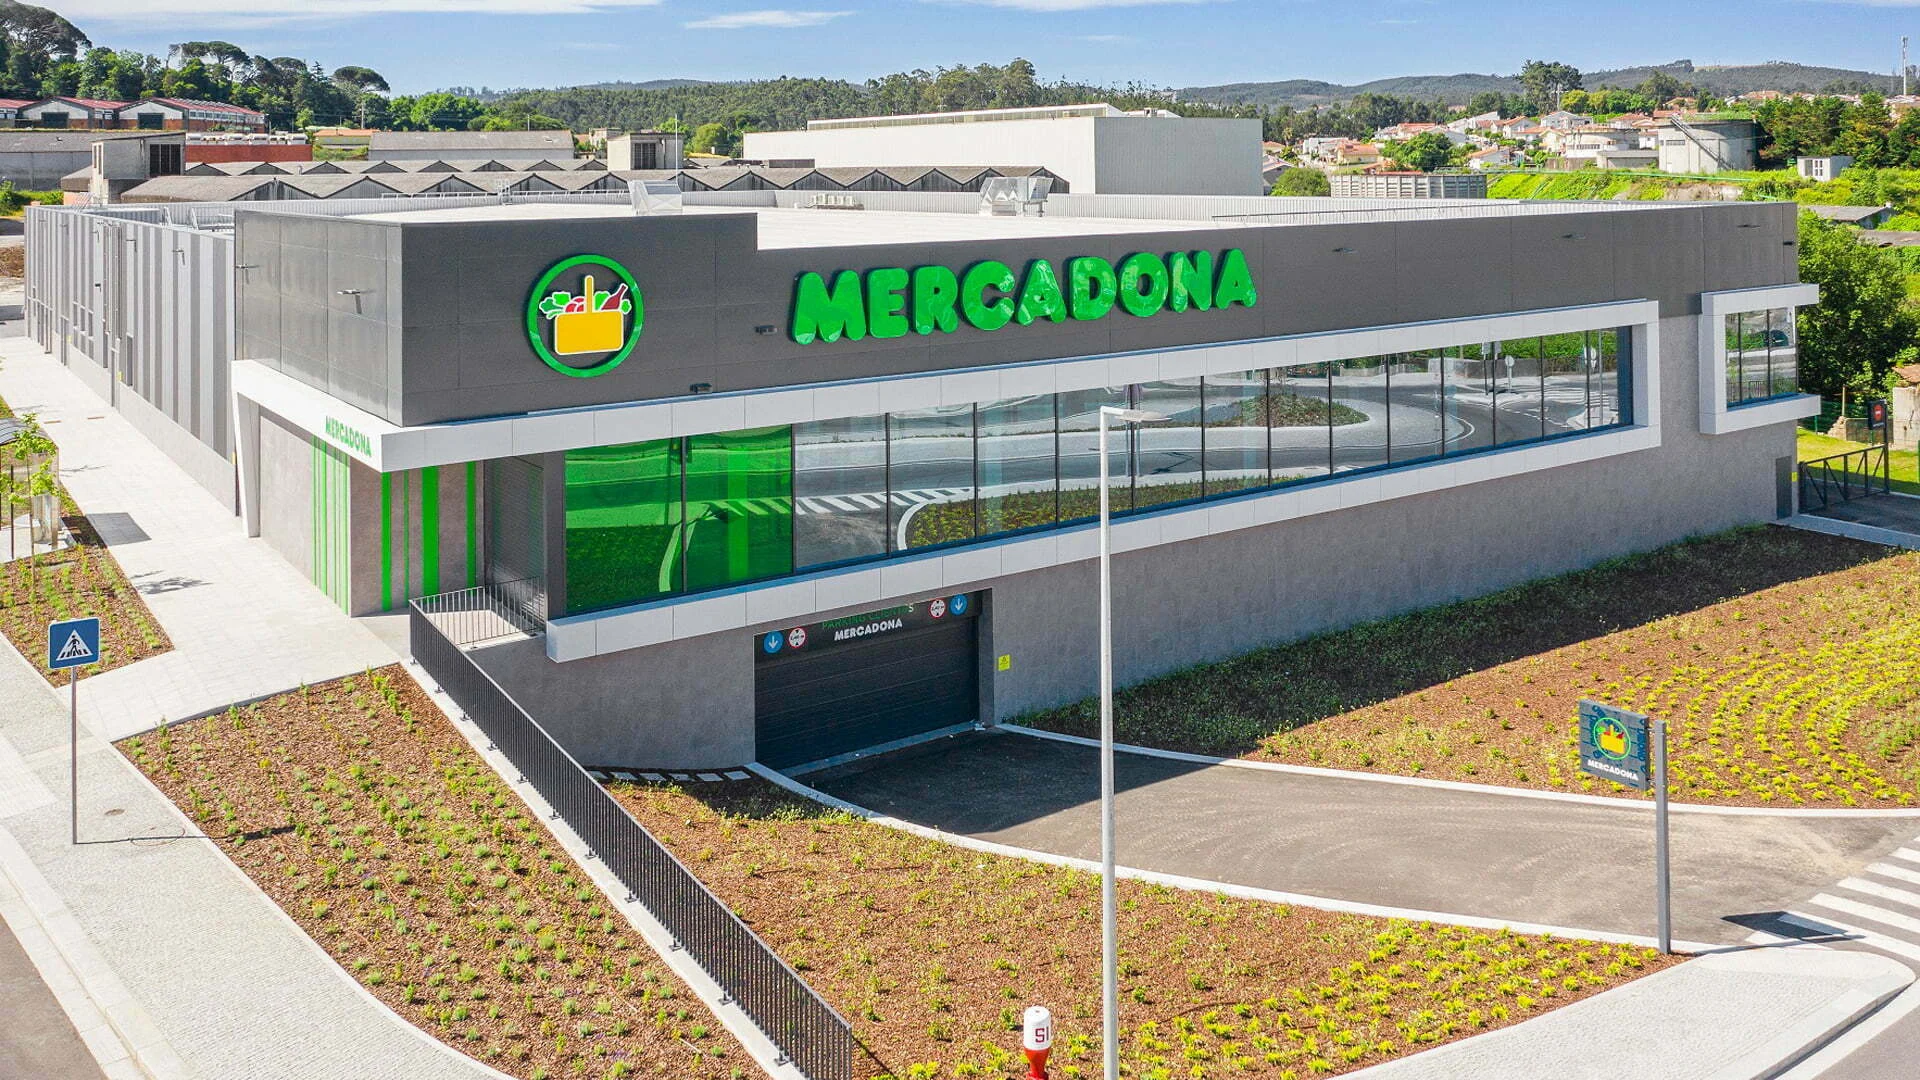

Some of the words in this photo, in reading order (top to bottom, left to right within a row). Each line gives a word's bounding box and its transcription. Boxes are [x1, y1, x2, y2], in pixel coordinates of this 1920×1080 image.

[791, 247, 1257, 344] MERCADONA
[325, 415, 372, 458] MERCADONA
[834, 618, 903, 641] MERCADONA
[1587, 759, 1639, 781] MERCADONA
